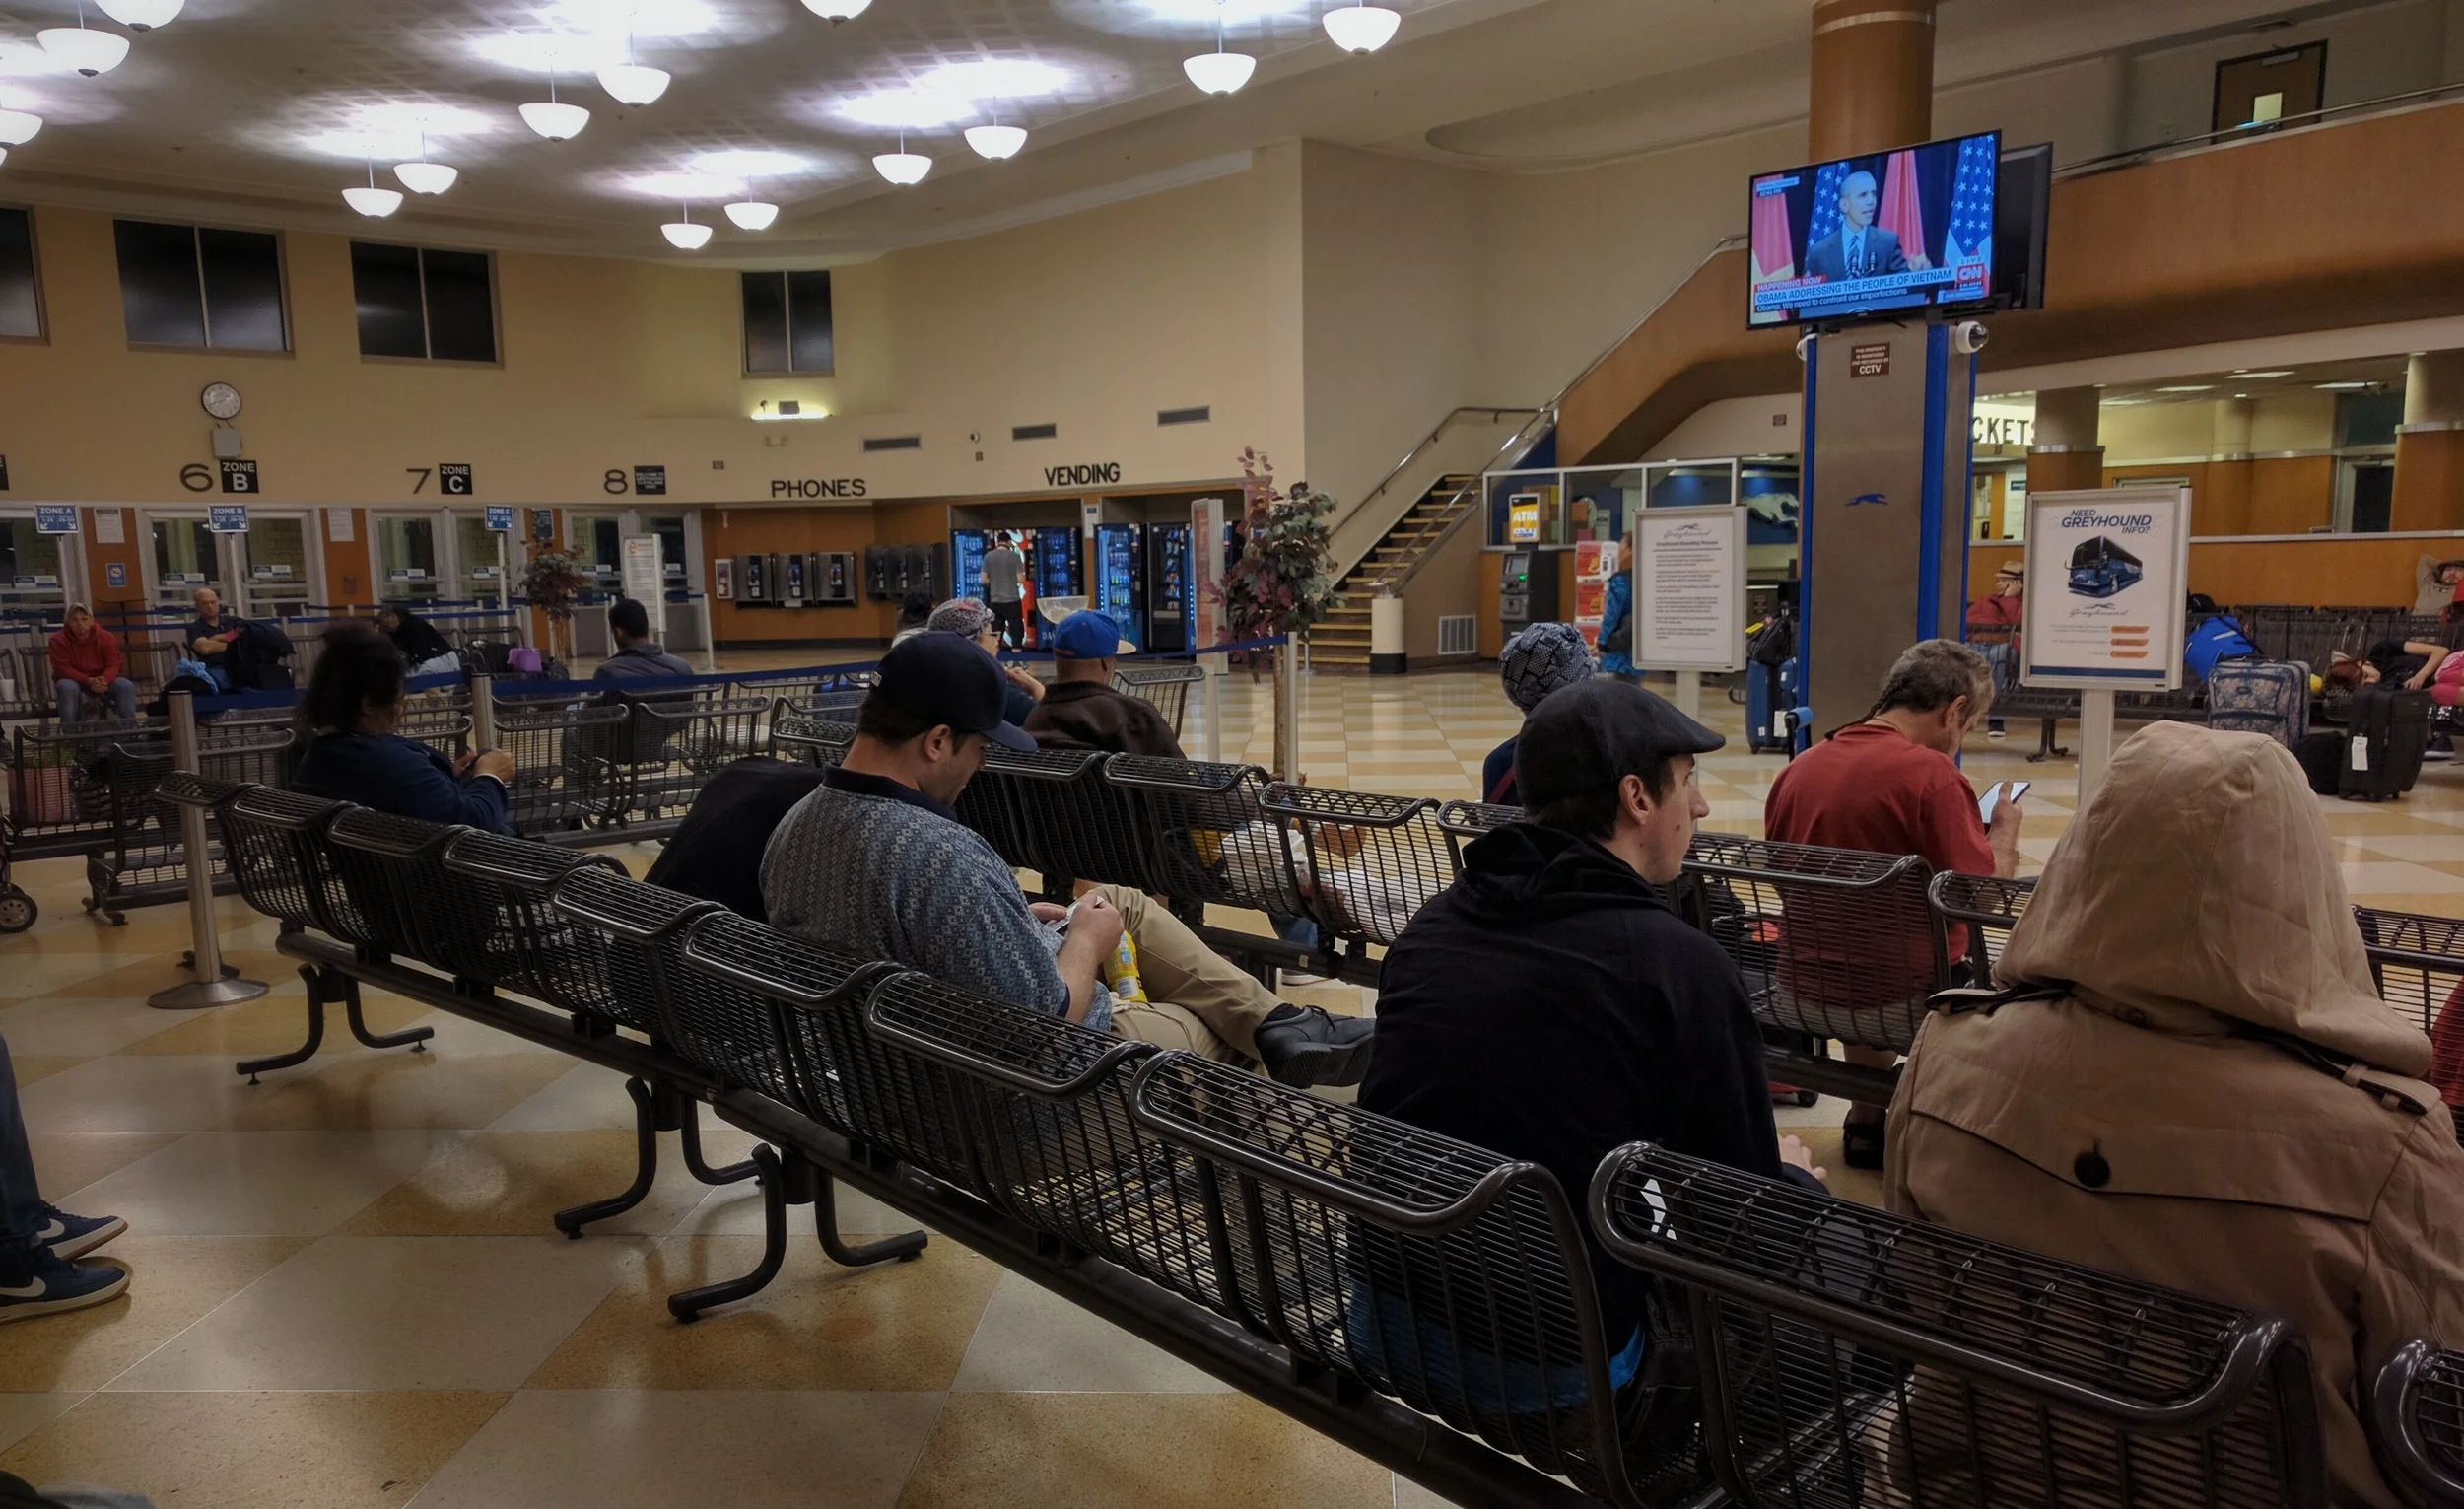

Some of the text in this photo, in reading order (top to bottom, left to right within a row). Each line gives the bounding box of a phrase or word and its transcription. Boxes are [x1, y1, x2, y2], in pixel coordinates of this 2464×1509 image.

[1959, 265, 1982, 281] CNN
[1757, 276, 1821, 291] HAPPENING NOW
[1757, 269, 1951, 303] OBAMA ADDRESSING THE PEOPLE OF VIETNAM
[1819, 296, 1847, 306] confront
[1861, 288, 1907, 300] imperfections
[1859, 364, 1882, 375] CCTV
[222, 461, 255, 473] ZONE
[441, 465, 469, 475] ZONE
[1044, 462, 1121, 486] VENDING
[180, 463, 214, 492] 6
[232, 473, 248, 491] B
[406, 468, 432, 494] 7
[448, 475, 464, 493] C
[604, 469, 628, 494] 8
[771, 478, 867, 498] PHONES
[1513, 511, 1538, 521] ATM
[2061, 514, 2153, 528] GREYHOUND
[2071, 509, 2096, 517] NEED
